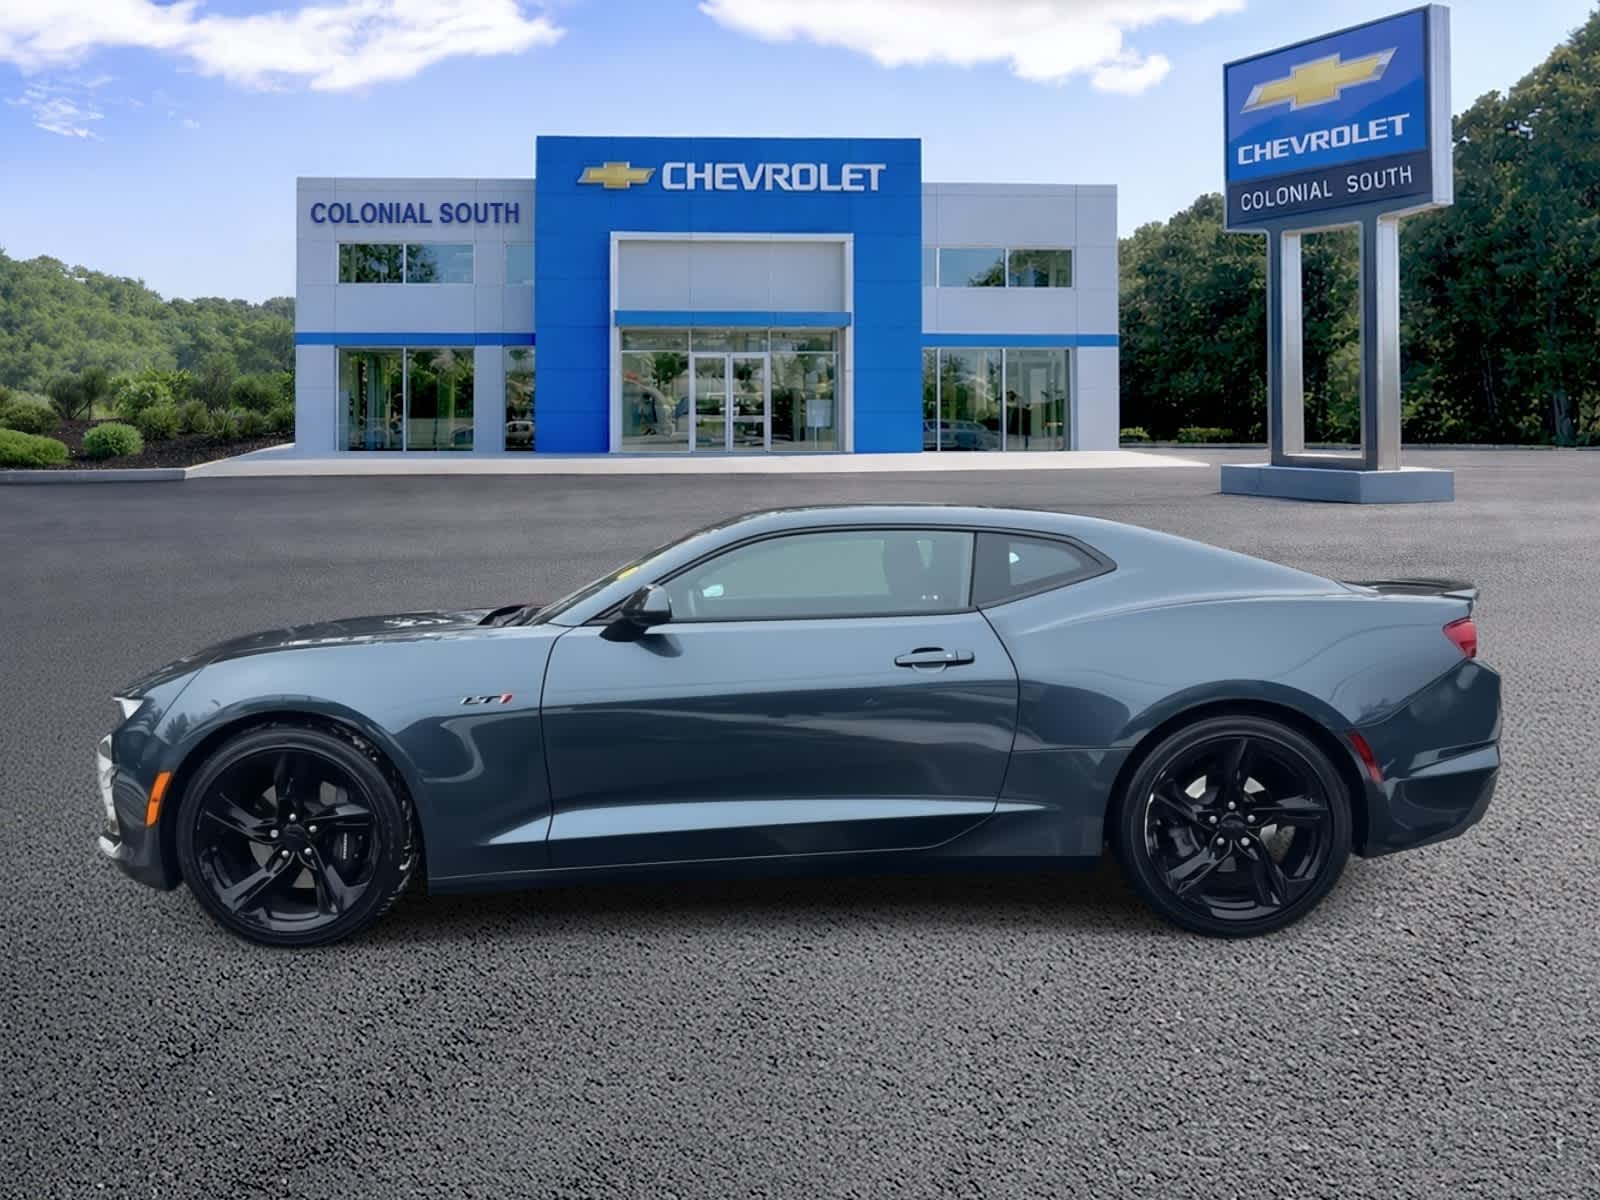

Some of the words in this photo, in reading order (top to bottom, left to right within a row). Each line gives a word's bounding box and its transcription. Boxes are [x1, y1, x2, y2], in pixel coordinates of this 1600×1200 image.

[1237, 113, 1410, 165] CHEVROLET
[662, 162, 886, 191] CHEVROLET
[1240, 180, 1333, 211] COLONIAL
[1346, 165, 1412, 193] SOUTH
[310, 202, 432, 224] COLONIAL
[439, 202, 520, 224] SOUTH
